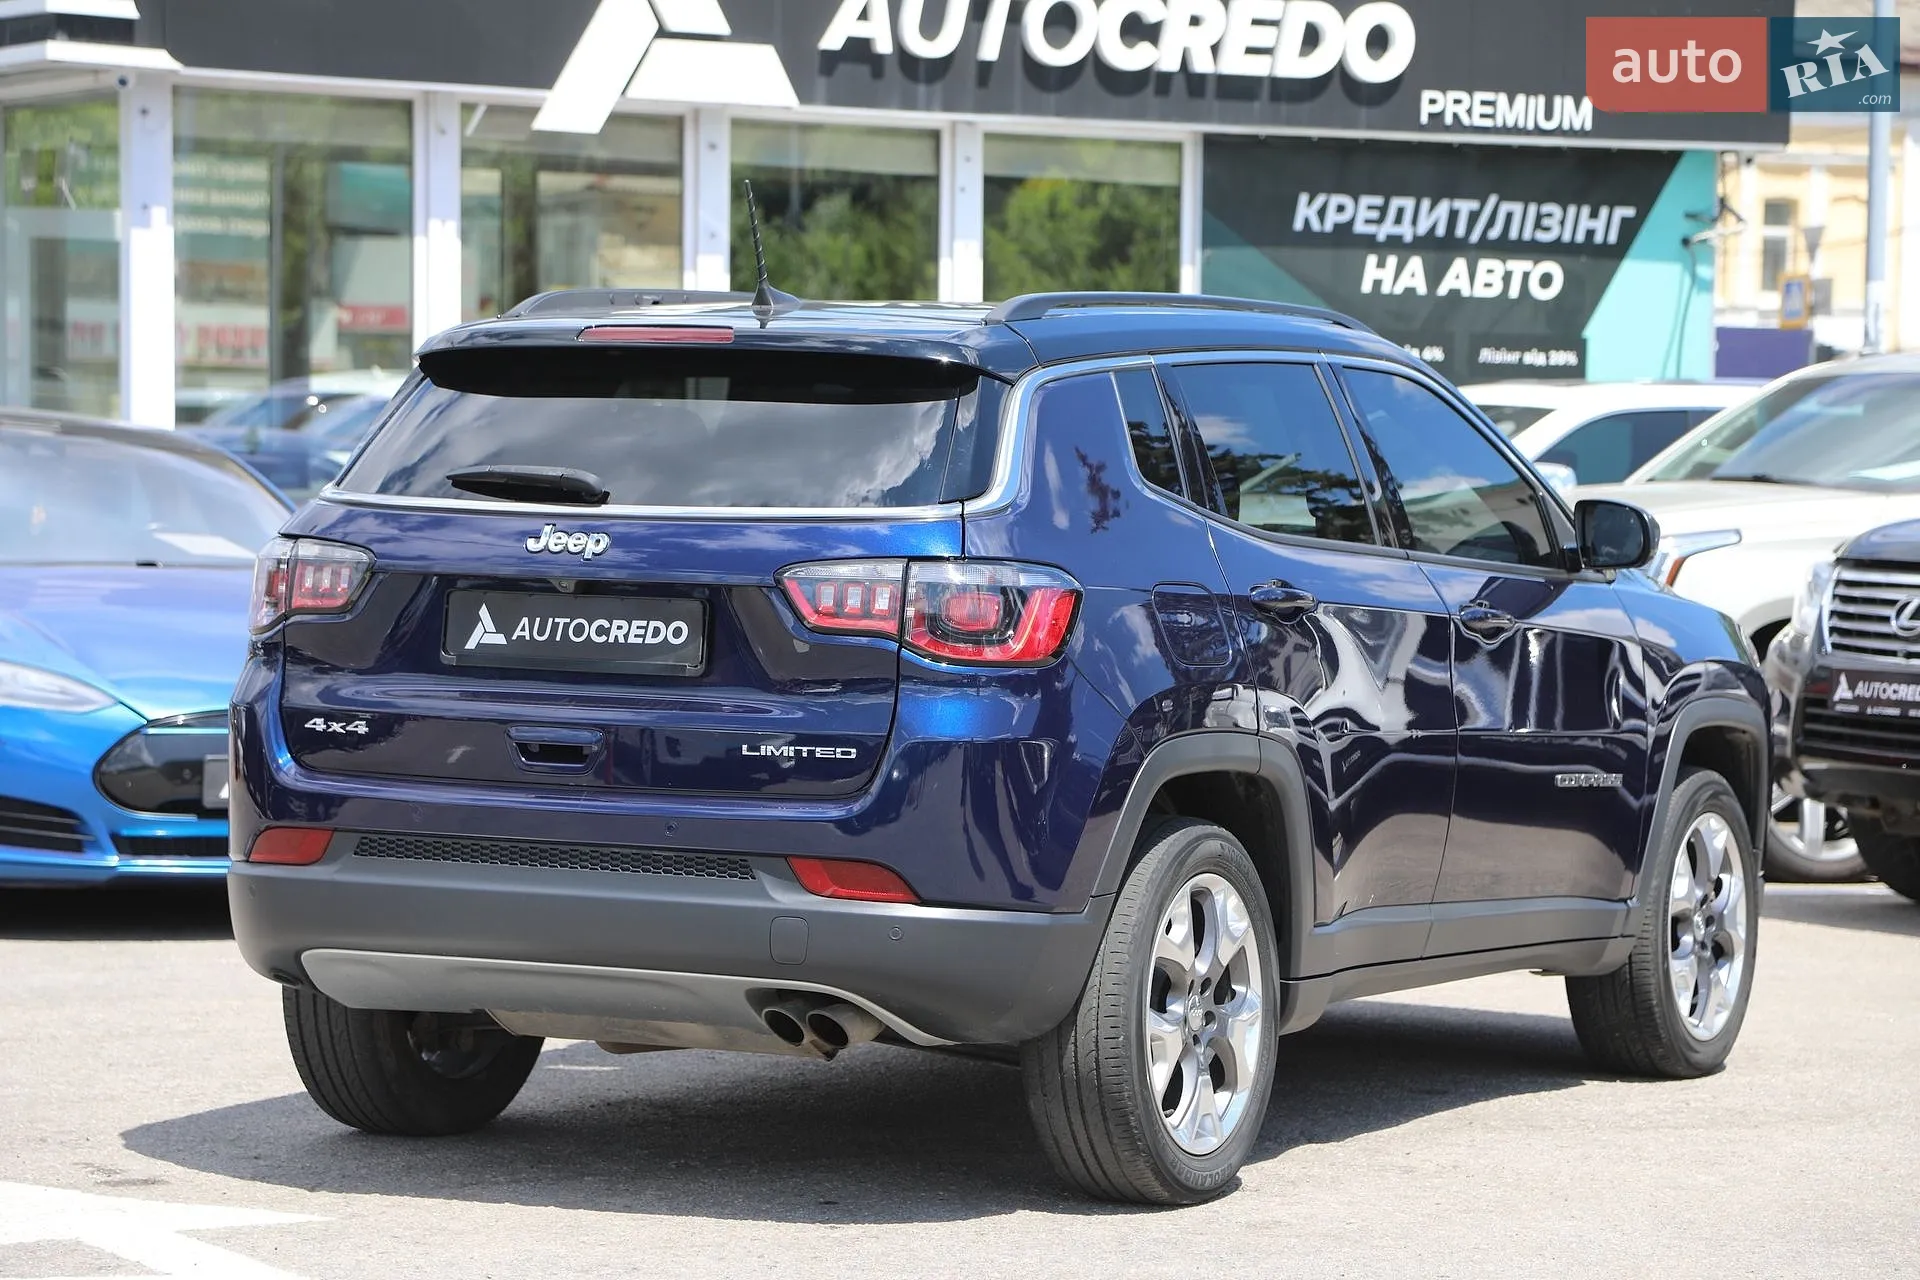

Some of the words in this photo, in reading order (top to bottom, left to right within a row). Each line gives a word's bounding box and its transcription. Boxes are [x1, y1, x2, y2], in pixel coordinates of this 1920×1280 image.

[818, 0, 1417, 84] AUTOCREDO
[1419, 89, 1594, 132] PREMIUM
[1292, 191, 1637, 245] КРЕДИТ/ЛІЗІНГ
[1360, 253, 1428, 296] НА
[1436, 256, 1565, 301] АВТО
[524, 523, 612, 561] Jeep
[512, 616, 689, 646] AUTOCREDO
[304, 717, 369, 735] 4x4
[741, 744, 857, 759] LIMITED
